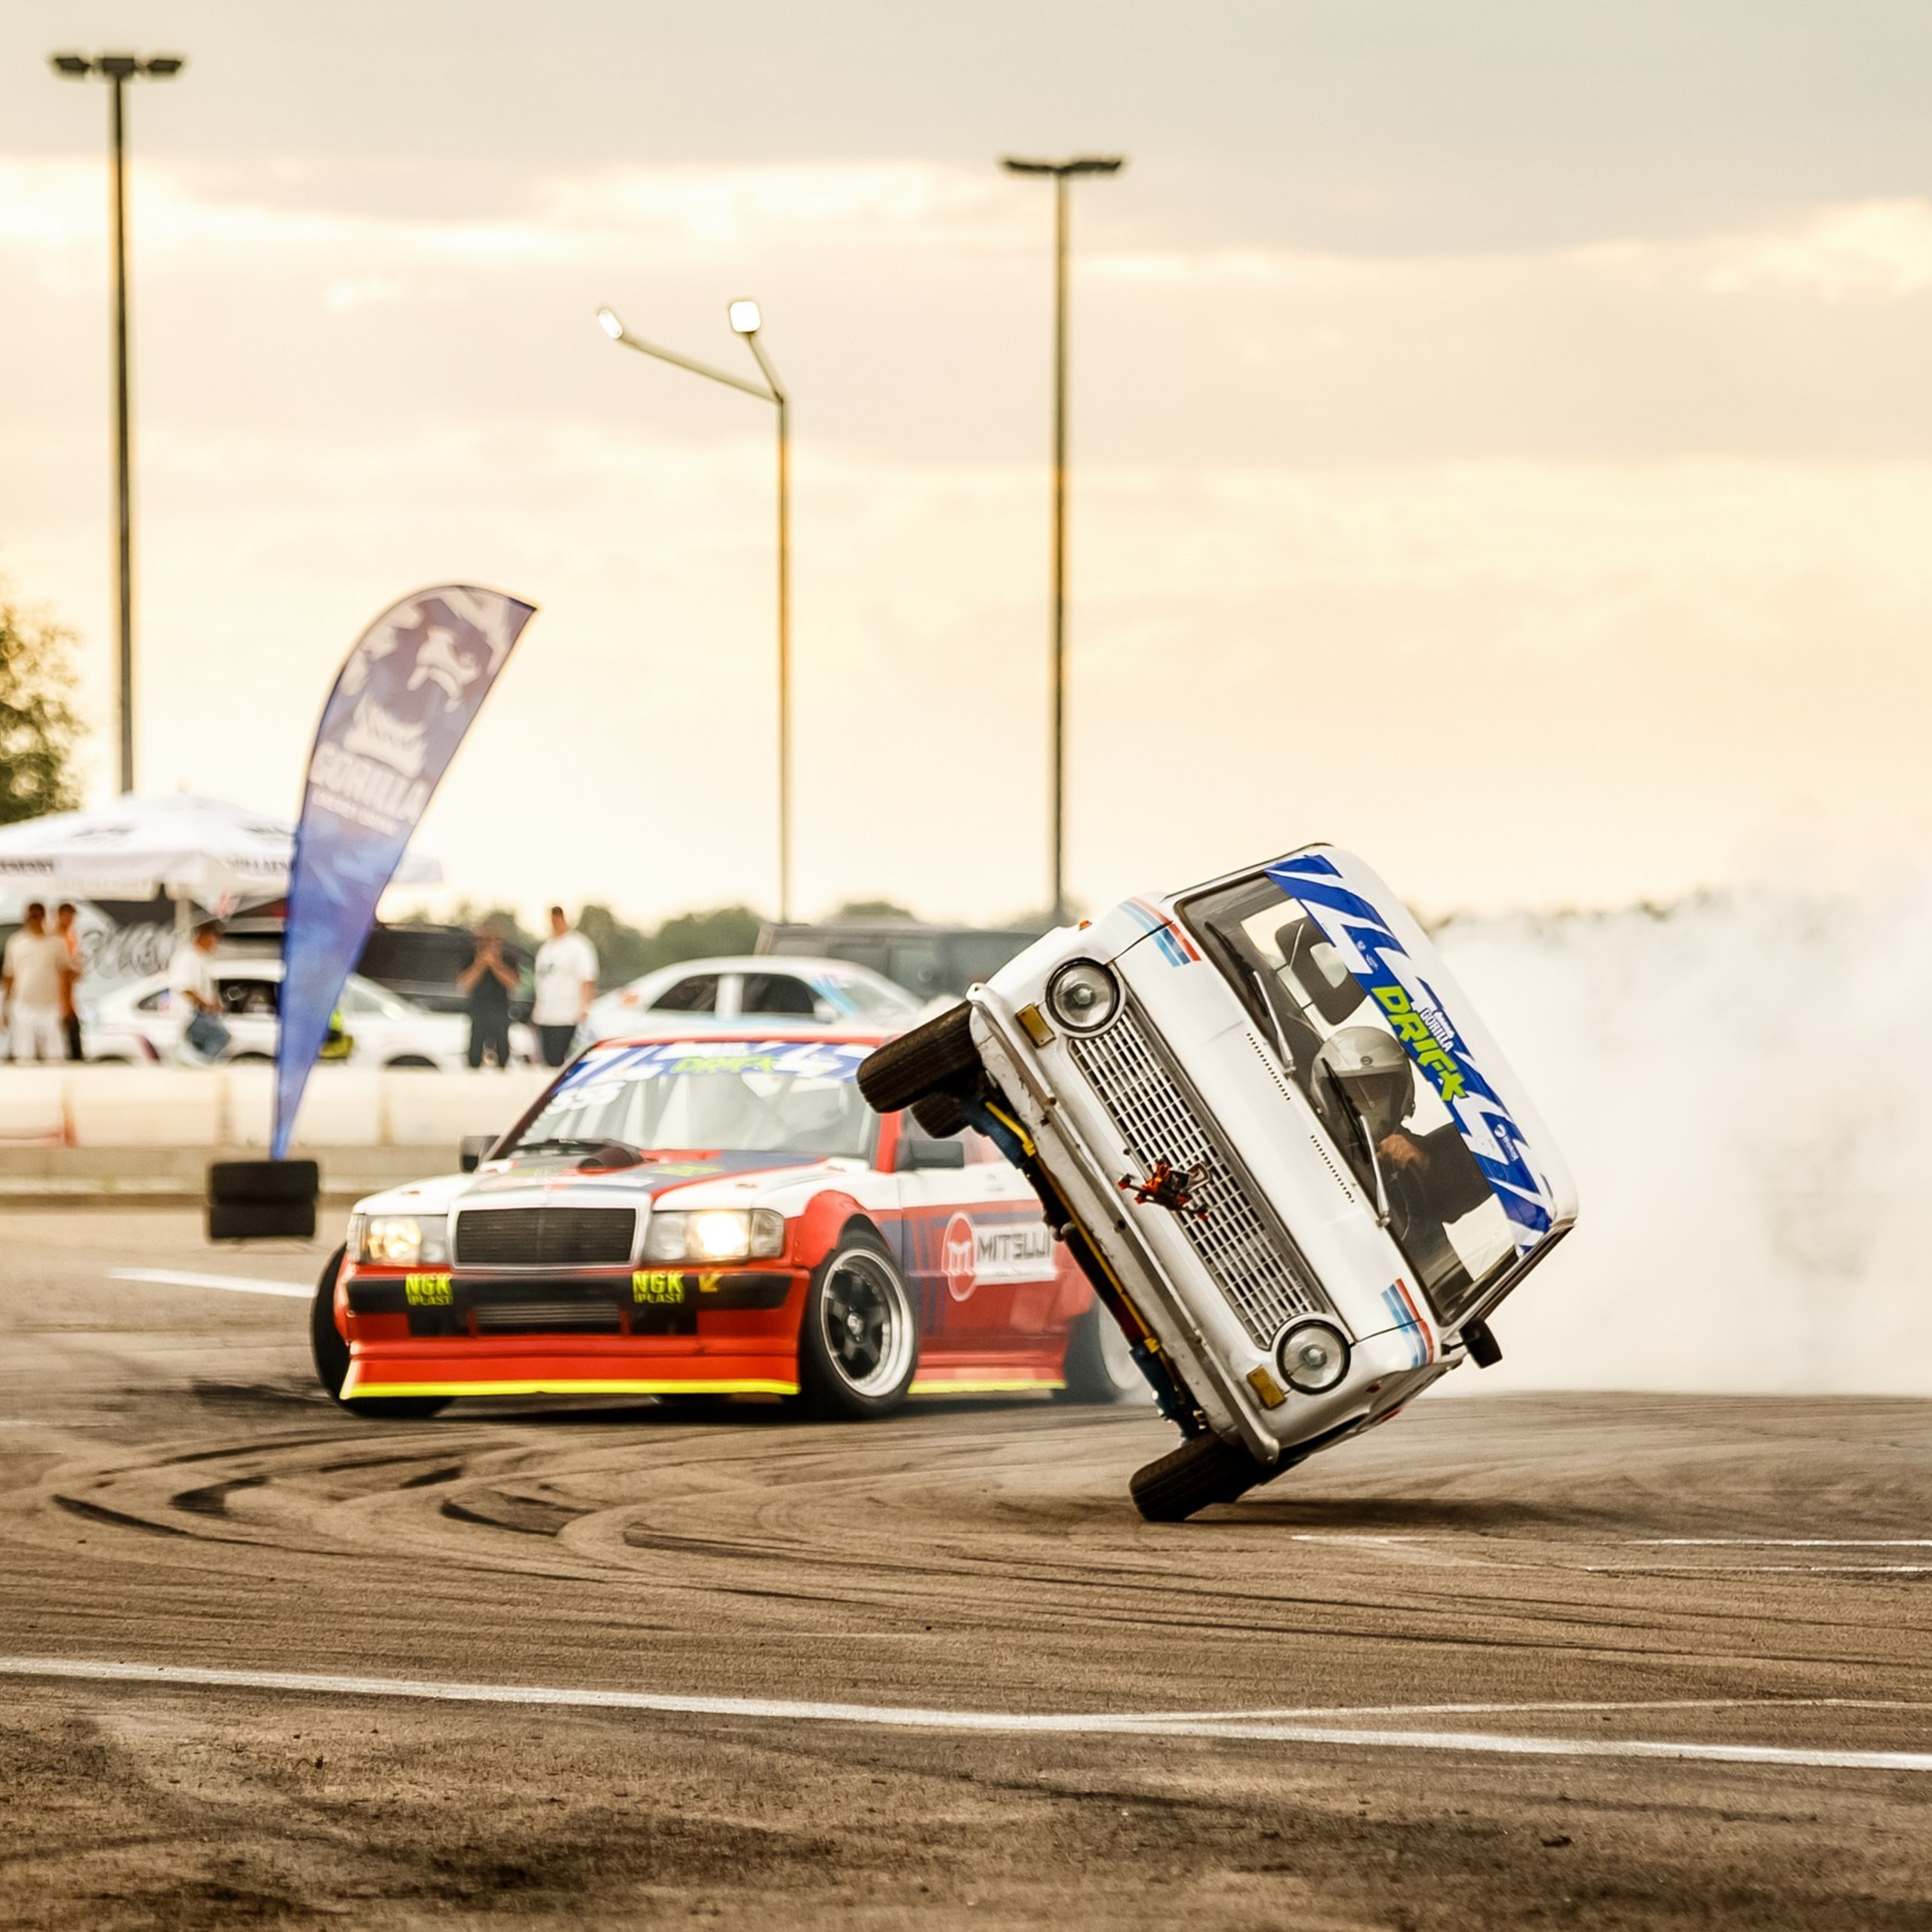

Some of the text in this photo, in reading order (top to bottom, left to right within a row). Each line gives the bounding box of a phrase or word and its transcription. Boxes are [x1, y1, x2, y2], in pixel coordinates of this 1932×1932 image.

[1371, 986, 1466, 1101] DRIFT
[1419, 1008, 1454, 1053] GORILLA
[406, 1273, 452, 1295] NGK
[632, 1271, 685, 1294] NGK
